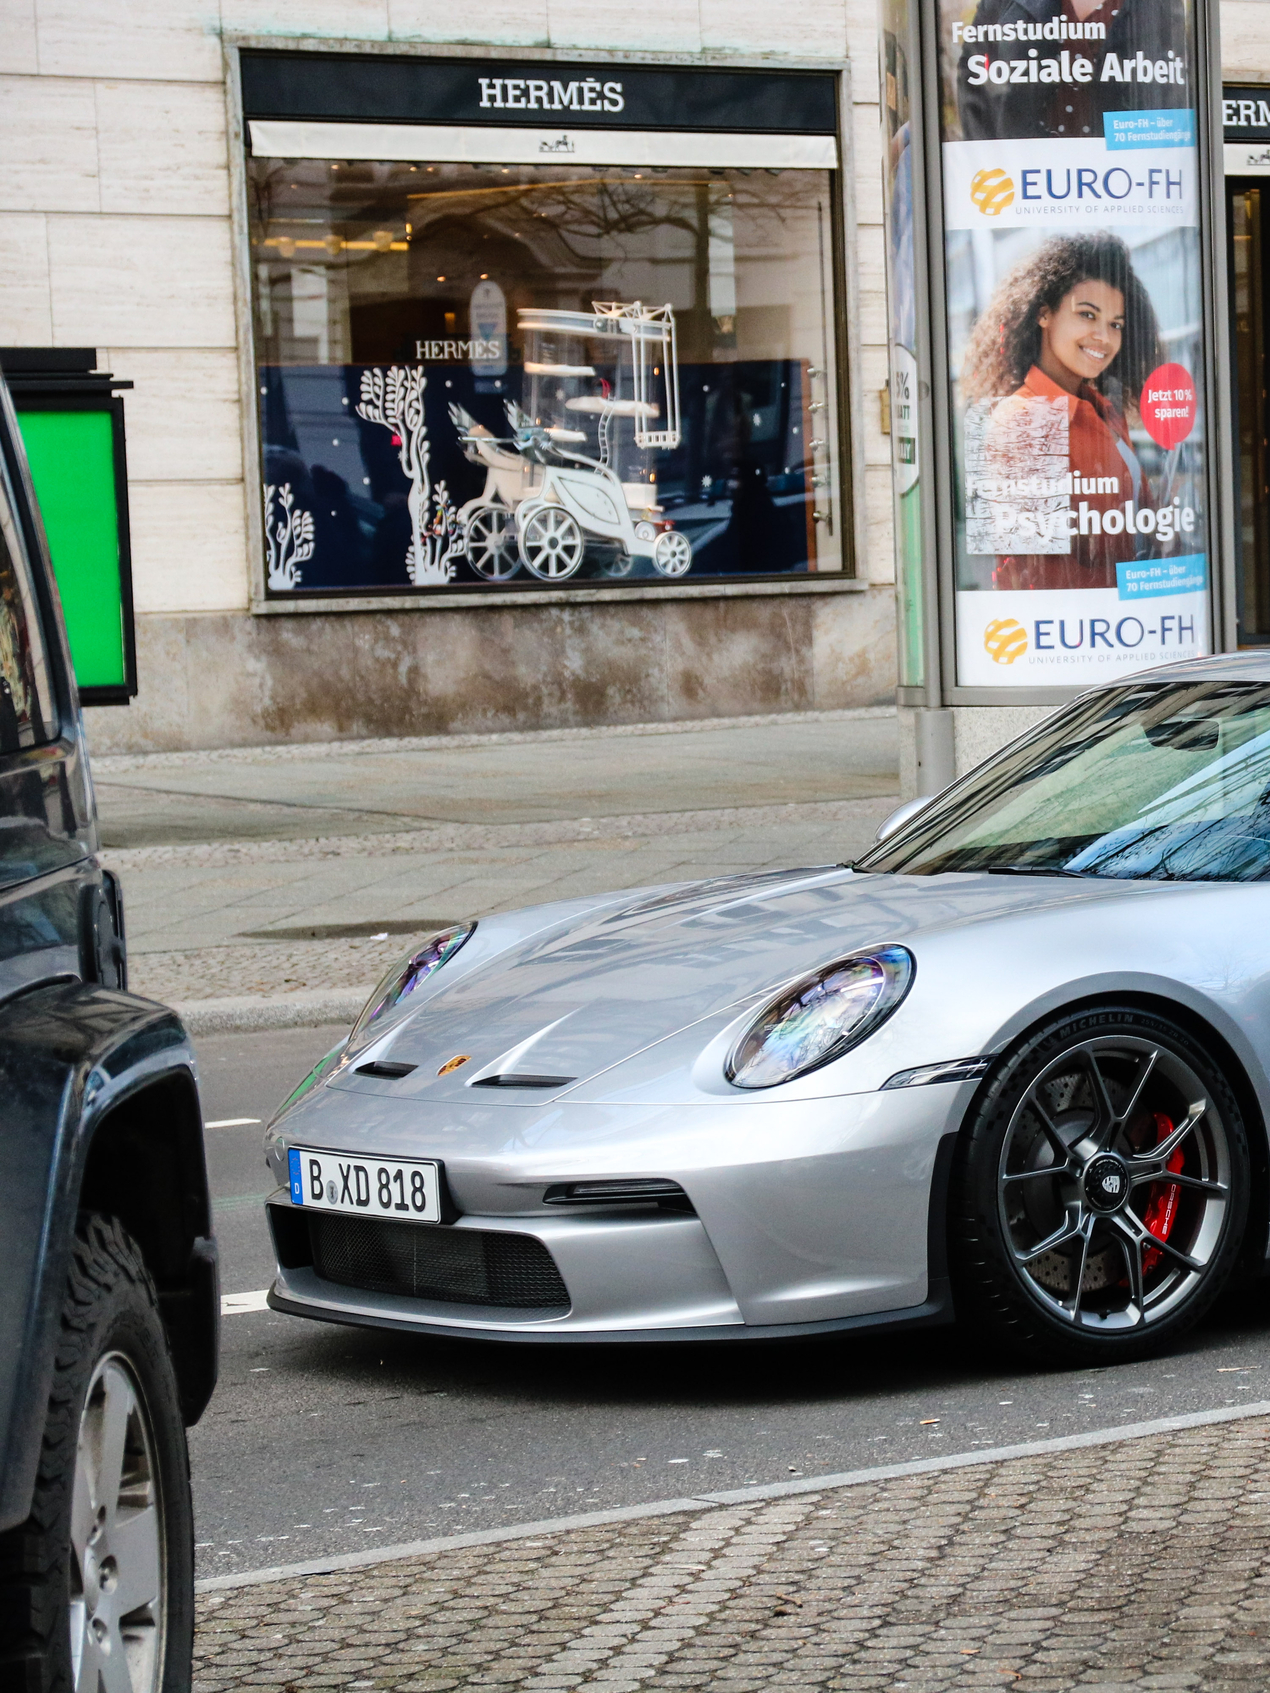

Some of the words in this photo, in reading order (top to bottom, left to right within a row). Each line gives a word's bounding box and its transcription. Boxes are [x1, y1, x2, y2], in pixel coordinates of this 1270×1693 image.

[951, 14, 1106, 43] Fernstudium
[967, 49, 1093, 86] Soziale
[1100, 50, 1185, 85] Arbeit
[1113, 118, 1149, 130] Euro-FH
[1156, 117, 1173, 128] über
[1114, 132, 1125, 142] 70
[1021, 167, 1183, 200] EURO-FH
[1015, 205, 1080, 215] UNIVERSITY
[1085, 205, 1099, 214] OF
[1103, 204, 1144, 214] APPLIED
[1147, 205, 1184, 214] SCIENCES
[1148, 389, 1173, 403] Jetzt
[1154, 406, 1189, 421] sparen!
[992, 497, 1195, 543] Psychologie
[1125, 568, 1162, 580] Euro-FH
[1169, 564, 1186, 576] über
[1126, 582, 1138, 593] 70
[1034, 614, 1195, 650] EURO-FH
[1028, 655, 1093, 665] UNIVERSITY
[1097, 654, 1111, 663] OF
[1115, 652, 1156, 662] APPLIED
[1159, 650, 1196, 660] SCIENCES
[1059, 1013, 1134, 1039] MICHELIN
[309, 1158, 324, 1201] B
[338, 1163, 370, 1207] XD
[377, 1167, 426, 1212] 818
[1161, 1183, 1176, 1235] ORSCHE
